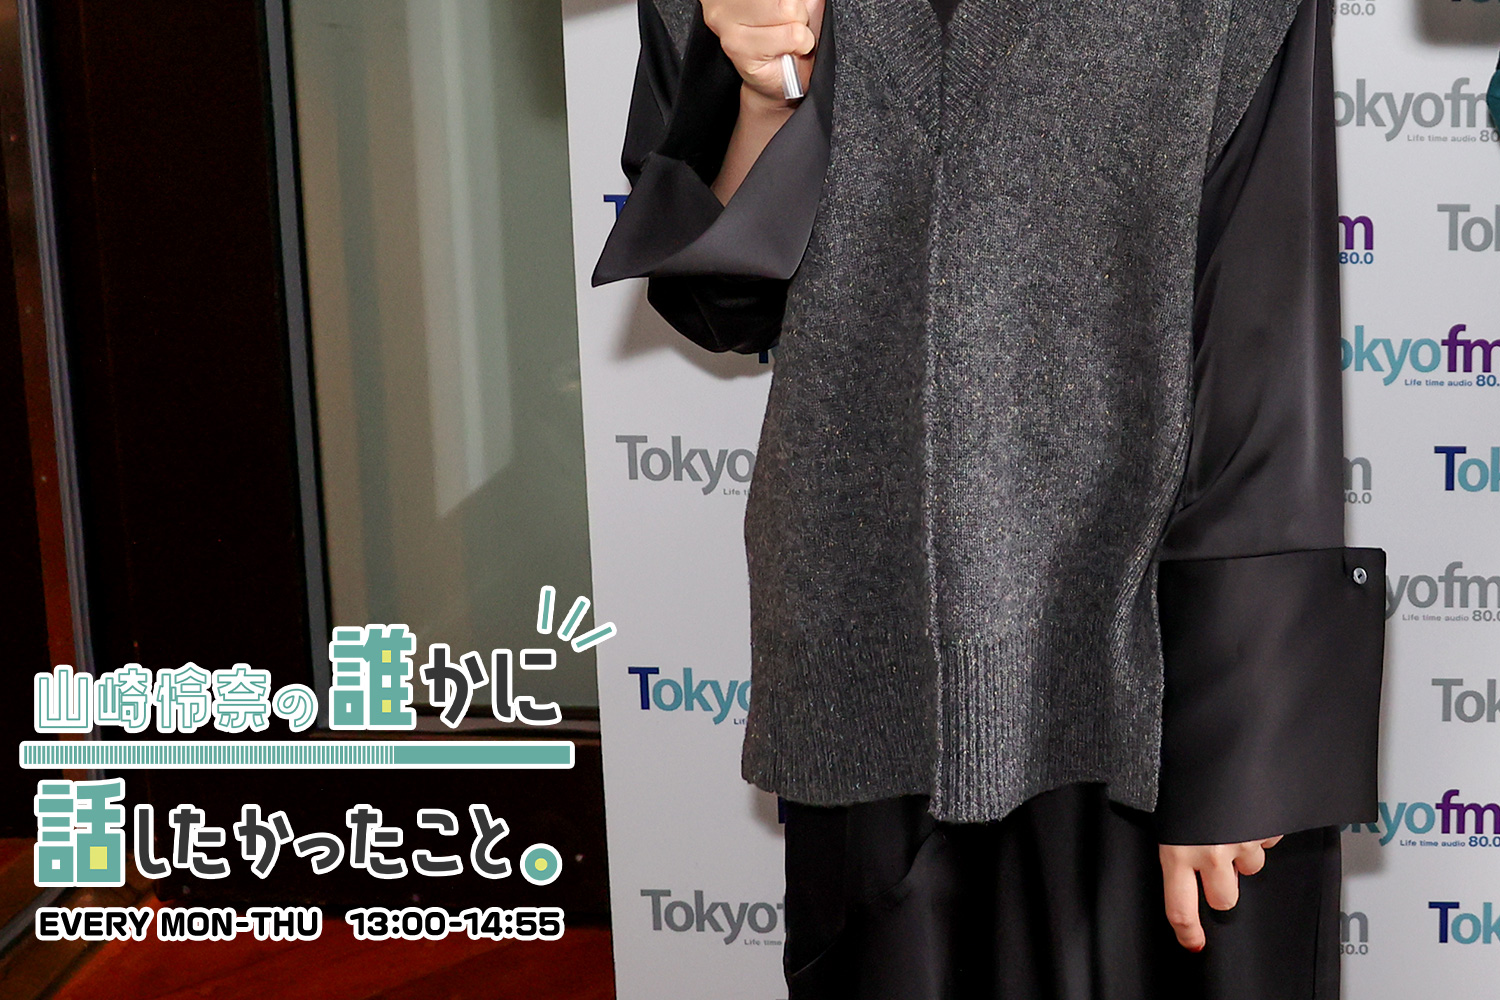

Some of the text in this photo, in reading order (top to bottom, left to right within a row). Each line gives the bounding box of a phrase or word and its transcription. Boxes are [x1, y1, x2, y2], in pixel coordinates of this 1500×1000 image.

[1339, 3, 1376, 16] 80.0
[1480, 130, 1500, 142] 80
[1404, 379, 1422, 387] Life
[1425, 379, 1445, 387] time
[1447, 379, 1473, 387] audio
[615, 434, 756, 495] Tokyo
[1344, 492, 1372, 504] 0.0
[640, 889, 784, 945] Tokyo
